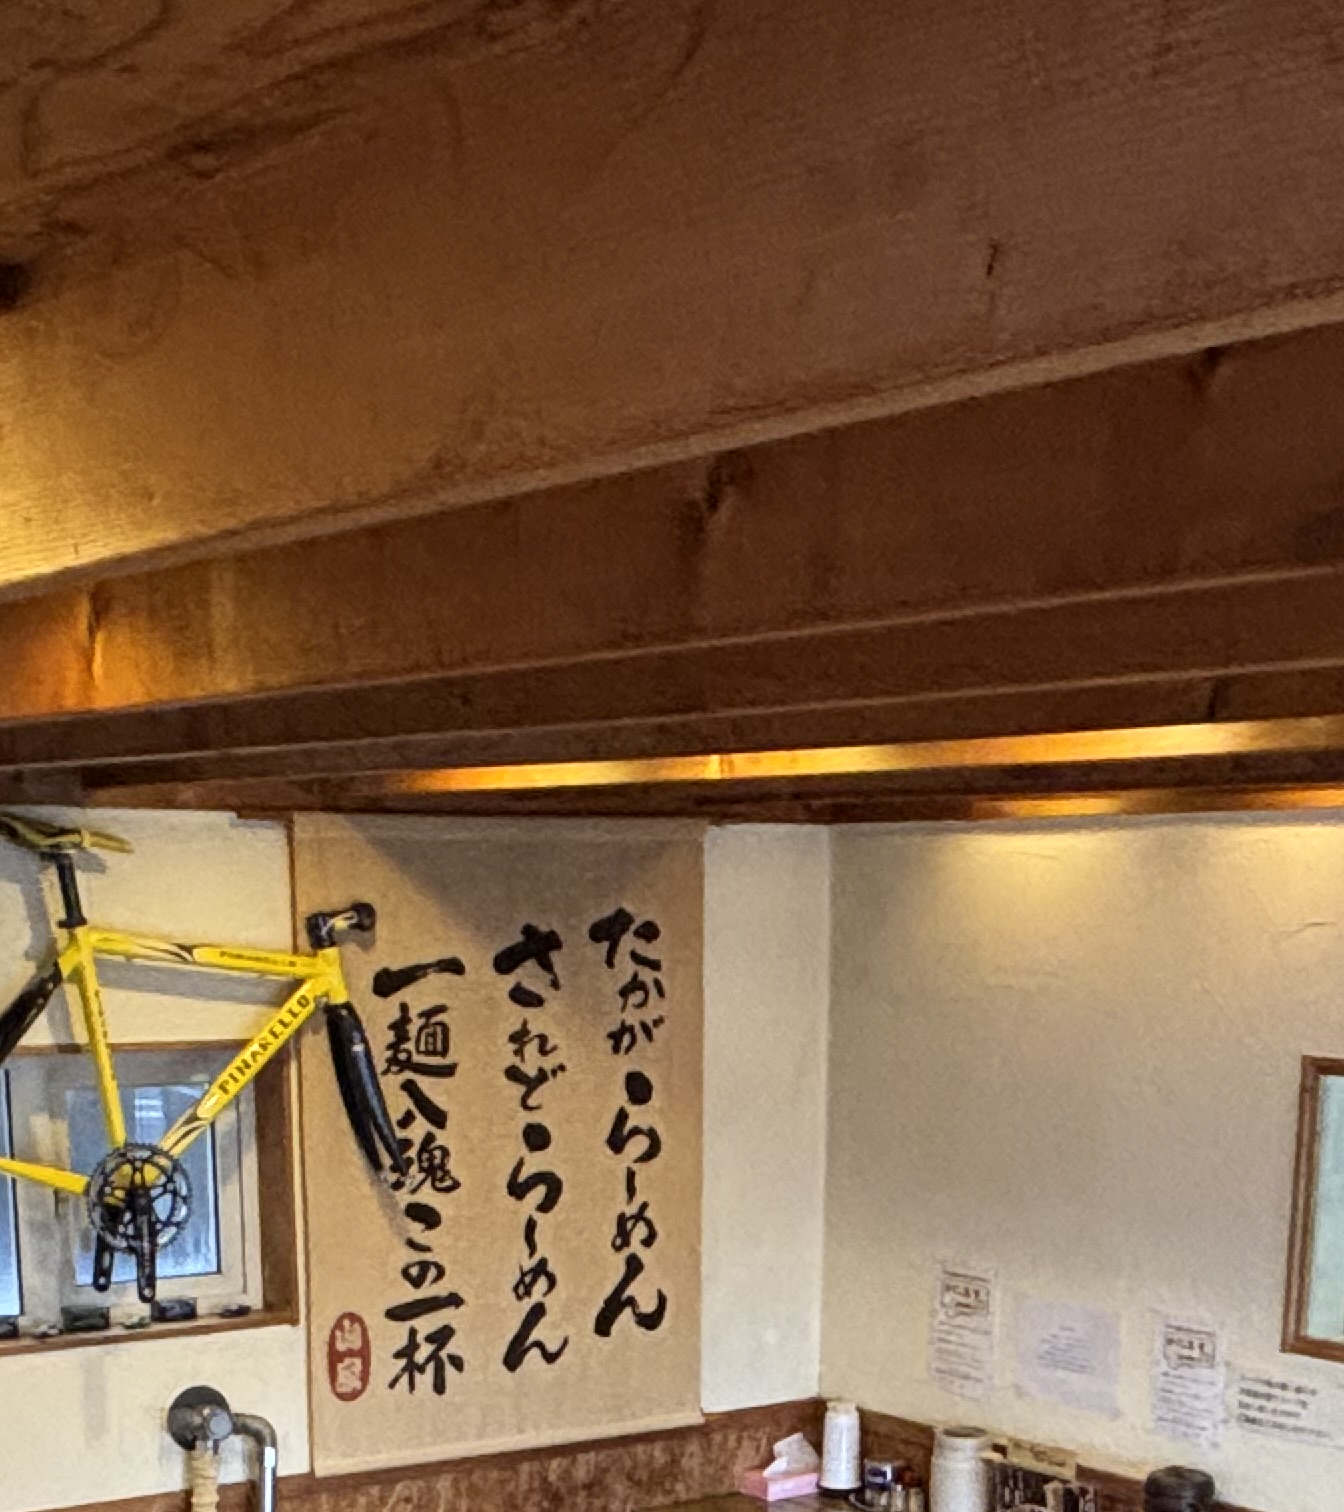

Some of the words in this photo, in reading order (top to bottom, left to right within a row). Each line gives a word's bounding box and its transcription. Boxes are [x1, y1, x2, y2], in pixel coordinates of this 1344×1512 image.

[218, 994, 310, 1095] PINARELLO
[493, 923, 569, 1373] されどらーめん
[589, 906, 666, 1338] たかがらーめん
